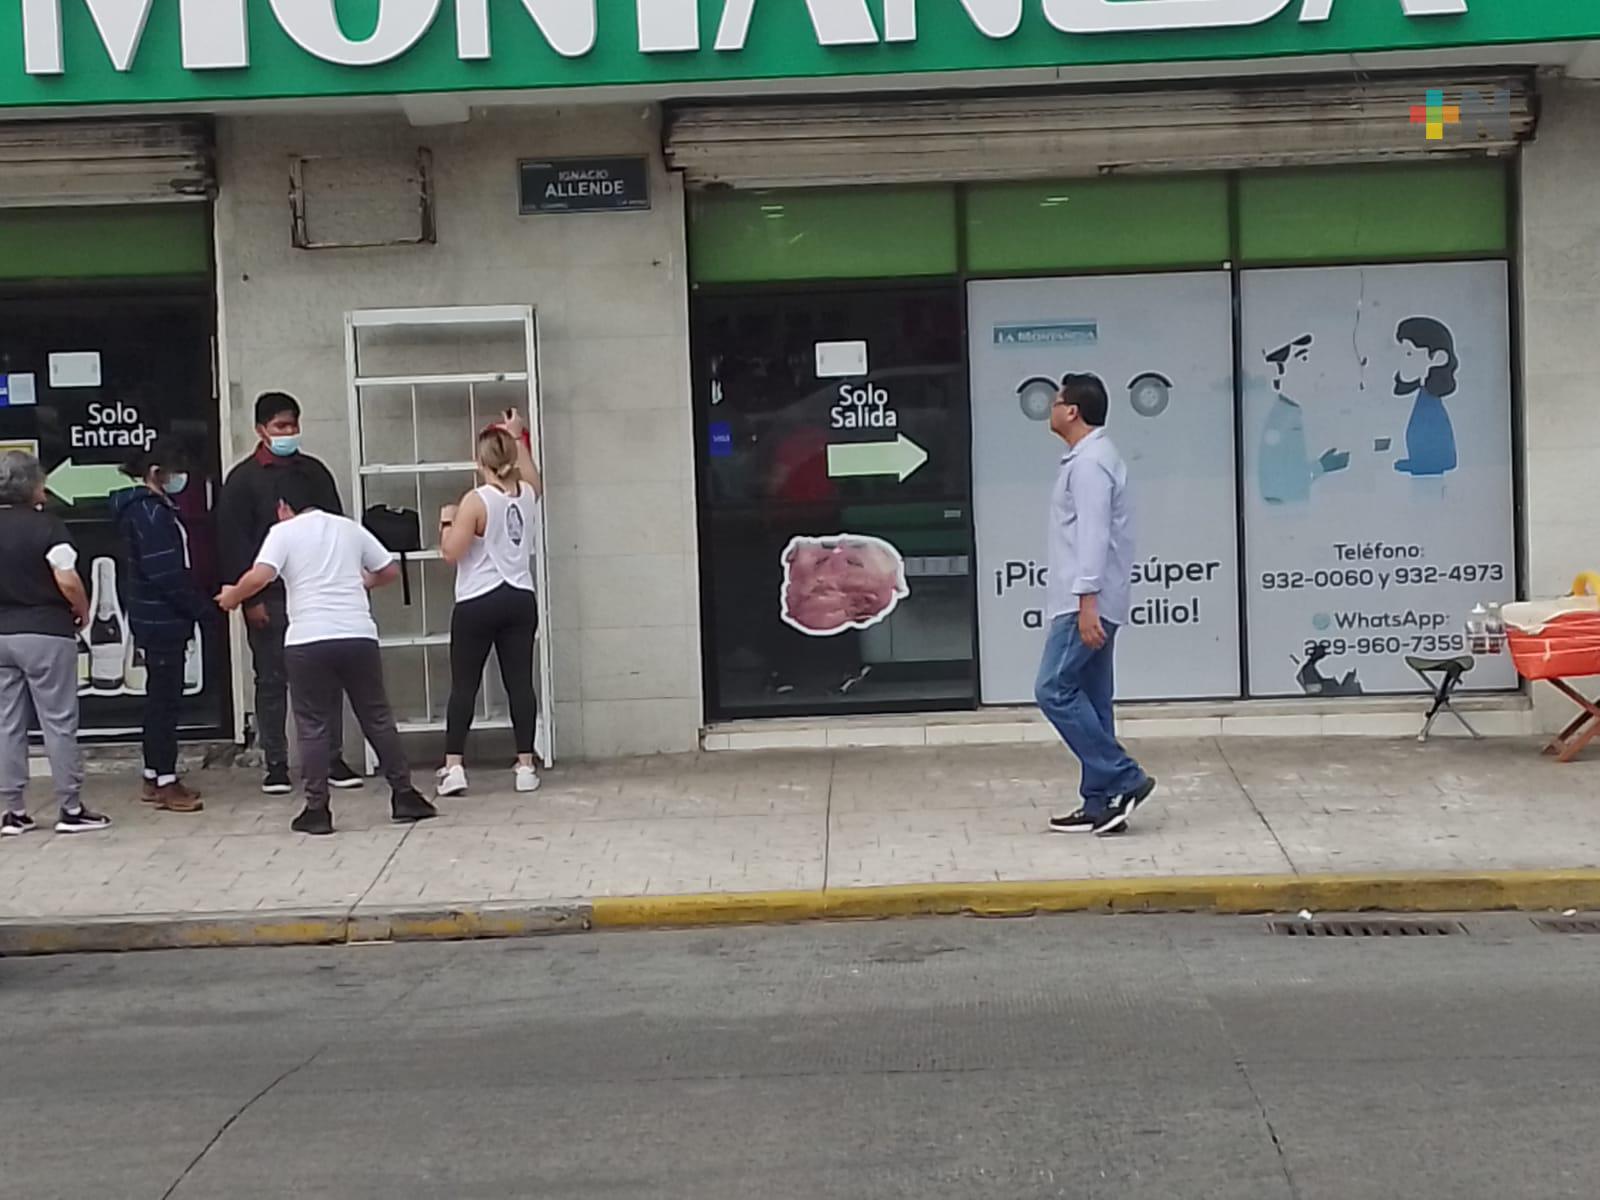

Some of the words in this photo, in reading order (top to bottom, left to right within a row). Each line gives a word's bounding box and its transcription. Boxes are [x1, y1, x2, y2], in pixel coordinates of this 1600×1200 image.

[558, 169, 608, 181] IGNACIO
[545, 180, 624, 198] ALLENDE
[838, 383, 888, 406] Solo
[88, 401, 138, 424] Solo
[831, 404, 897, 428] Salida
[1130, 556, 1220, 589] súper
[1262, 569, 1374, 589] 932-0060
[1379, 572, 1391, 590] y
[1395, 564, 1503, 584] 932-4973
